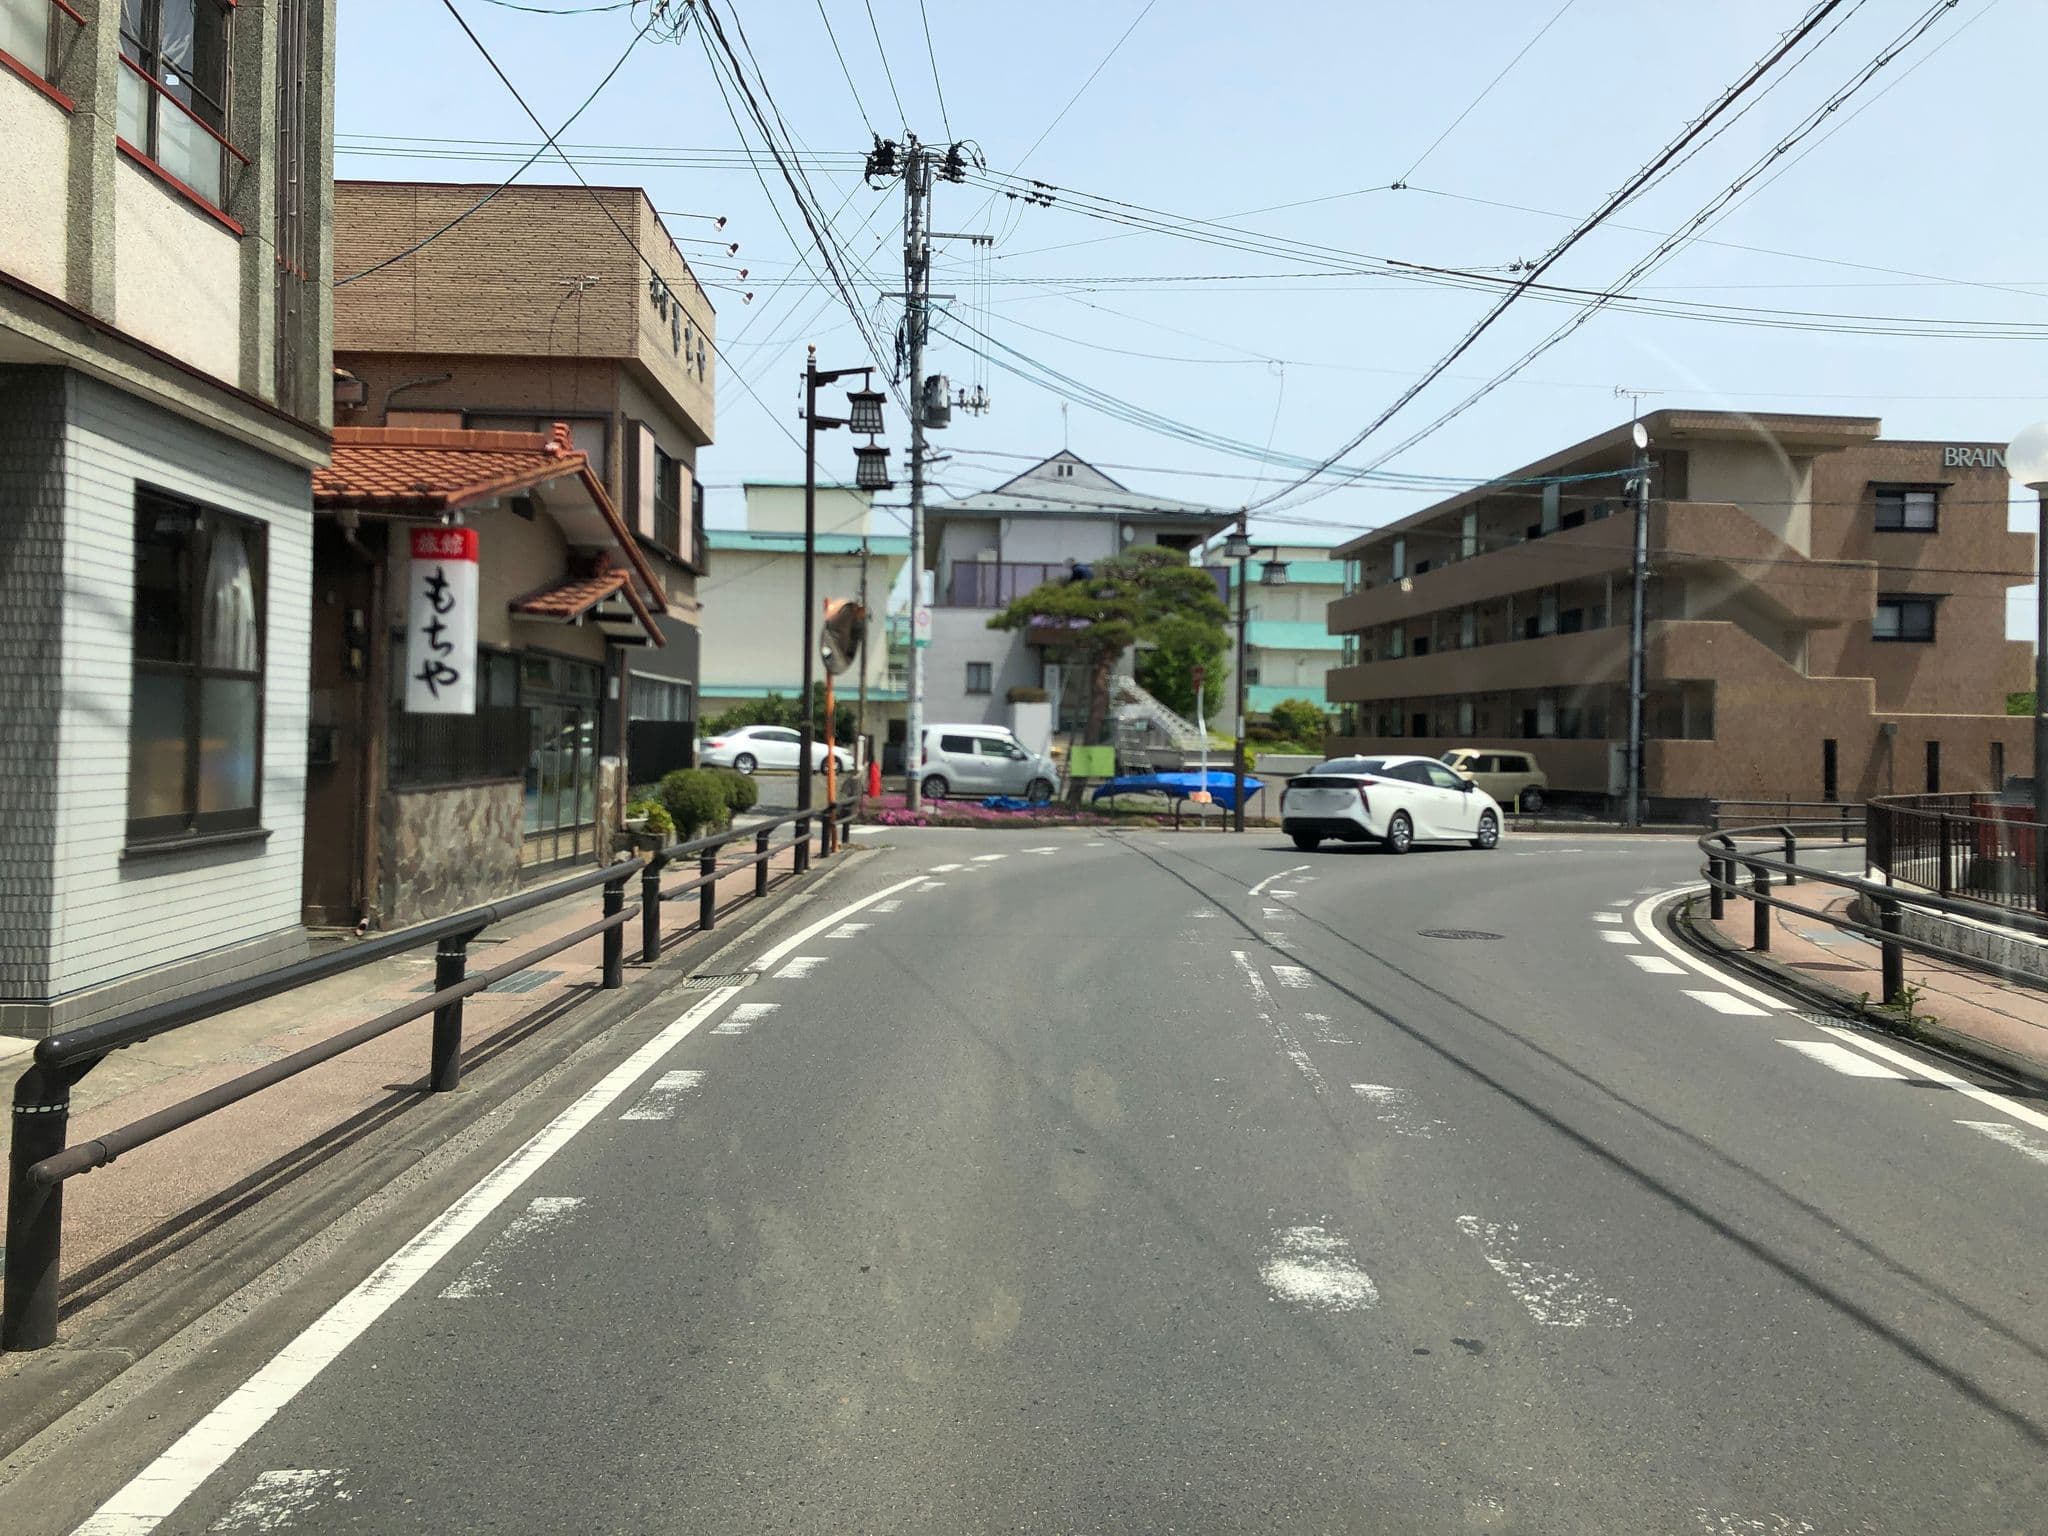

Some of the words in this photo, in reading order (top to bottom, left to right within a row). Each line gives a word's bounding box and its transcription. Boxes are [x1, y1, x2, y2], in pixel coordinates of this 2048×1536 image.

[1943, 447, 2008, 469] BRAIN
[414, 565, 460, 699] もちや
